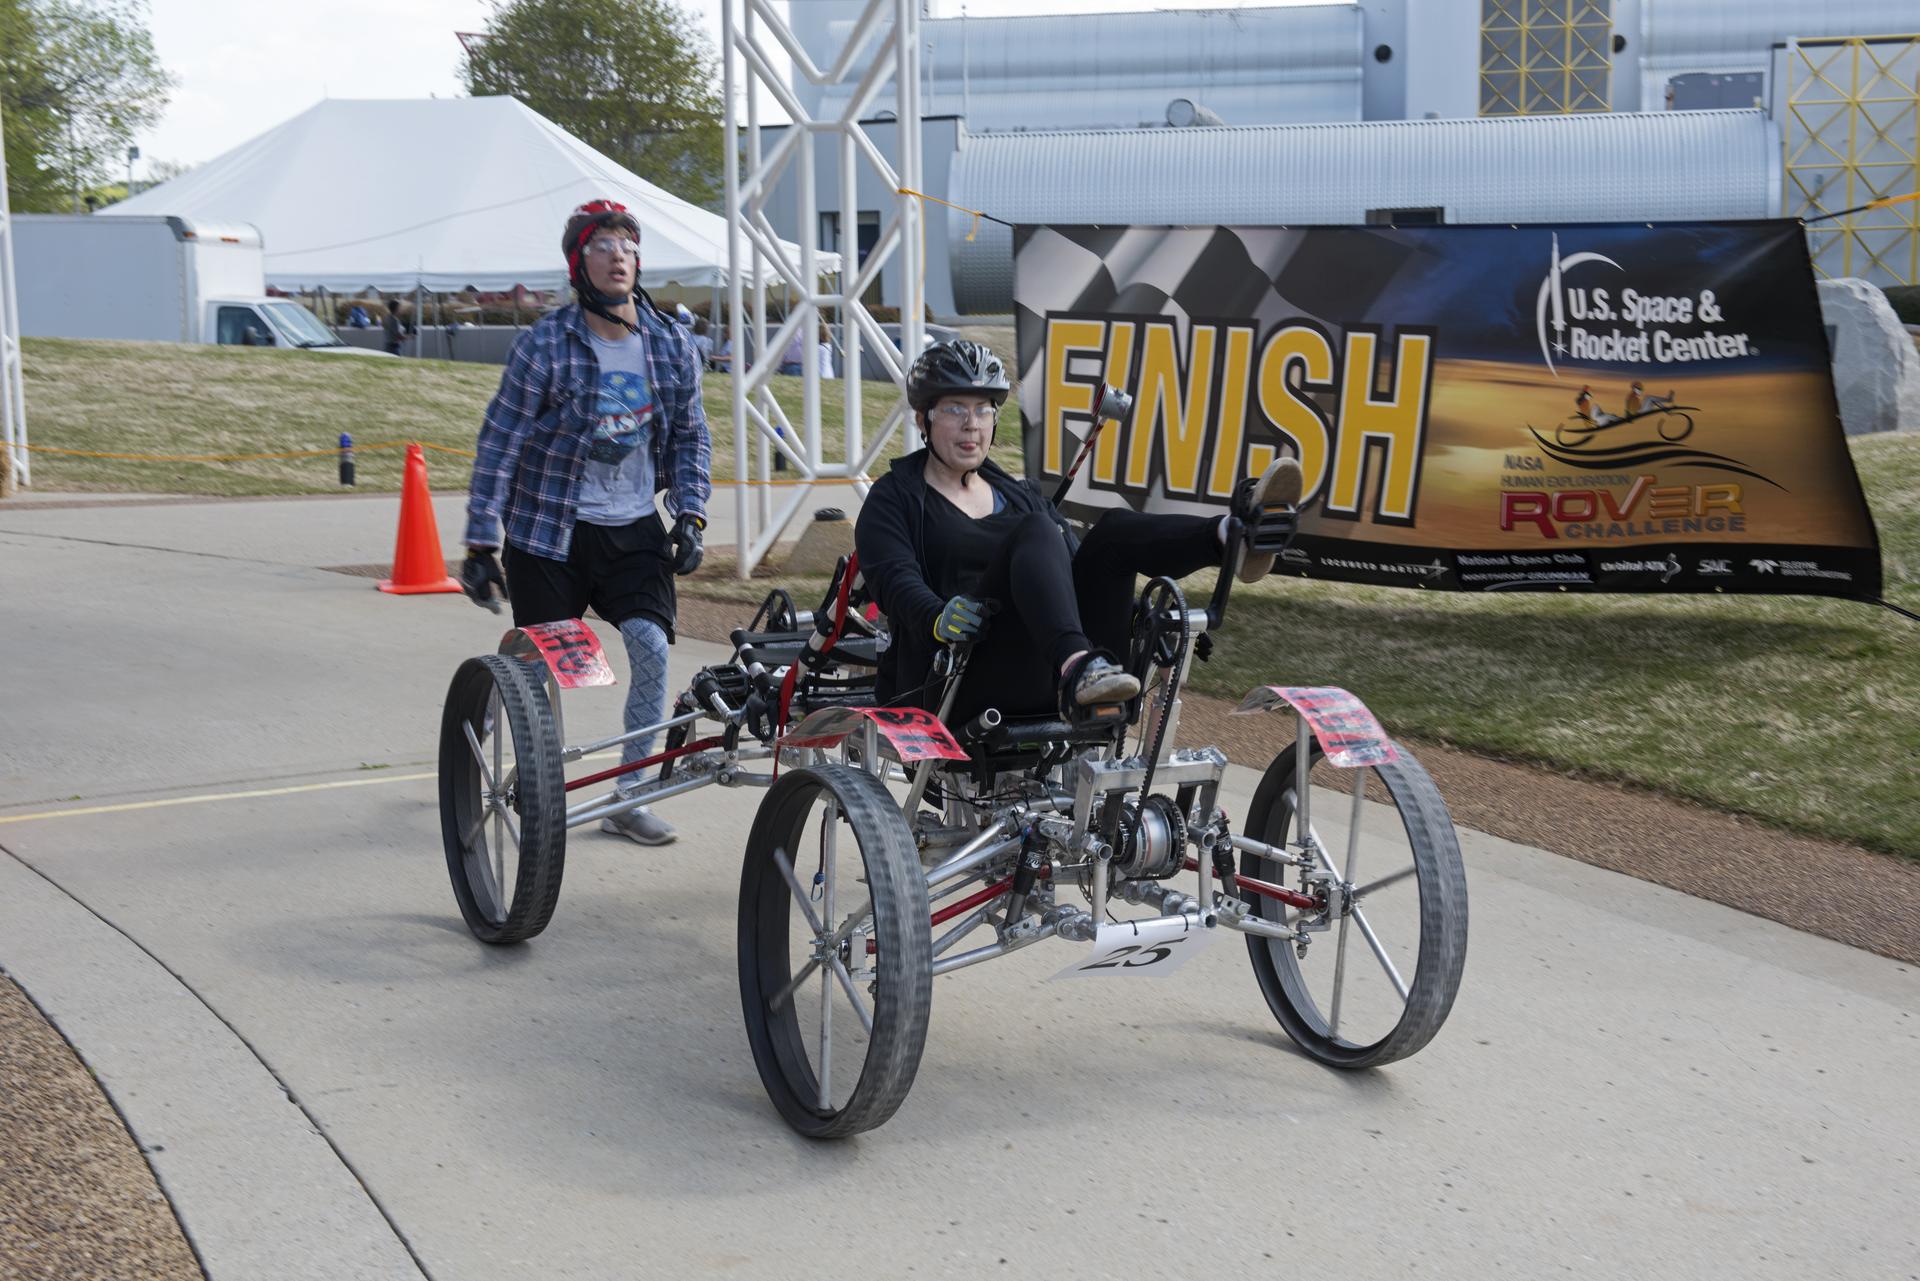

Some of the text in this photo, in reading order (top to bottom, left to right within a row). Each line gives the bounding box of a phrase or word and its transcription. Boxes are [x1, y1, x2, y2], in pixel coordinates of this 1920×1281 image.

[1567, 287, 1726, 329] U.S. Space &
[1570, 326, 1750, 363] Rocket Center
[1041, 313, 1435, 524] FINISH
[1503, 454, 1545, 471] NASA
[1501, 474, 1631, 488] HUMAN EXPLORATION
[1500, 474, 1746, 539] ROVER
[1564, 515, 1747, 539] CHALLENGE
[1320, 556, 1378, 571] LOCKHEED
[1379, 563, 1428, 575] MARTIN
[1456, 553, 1586, 566] National Space Club
[1078, 936, 1189, 971] 25
